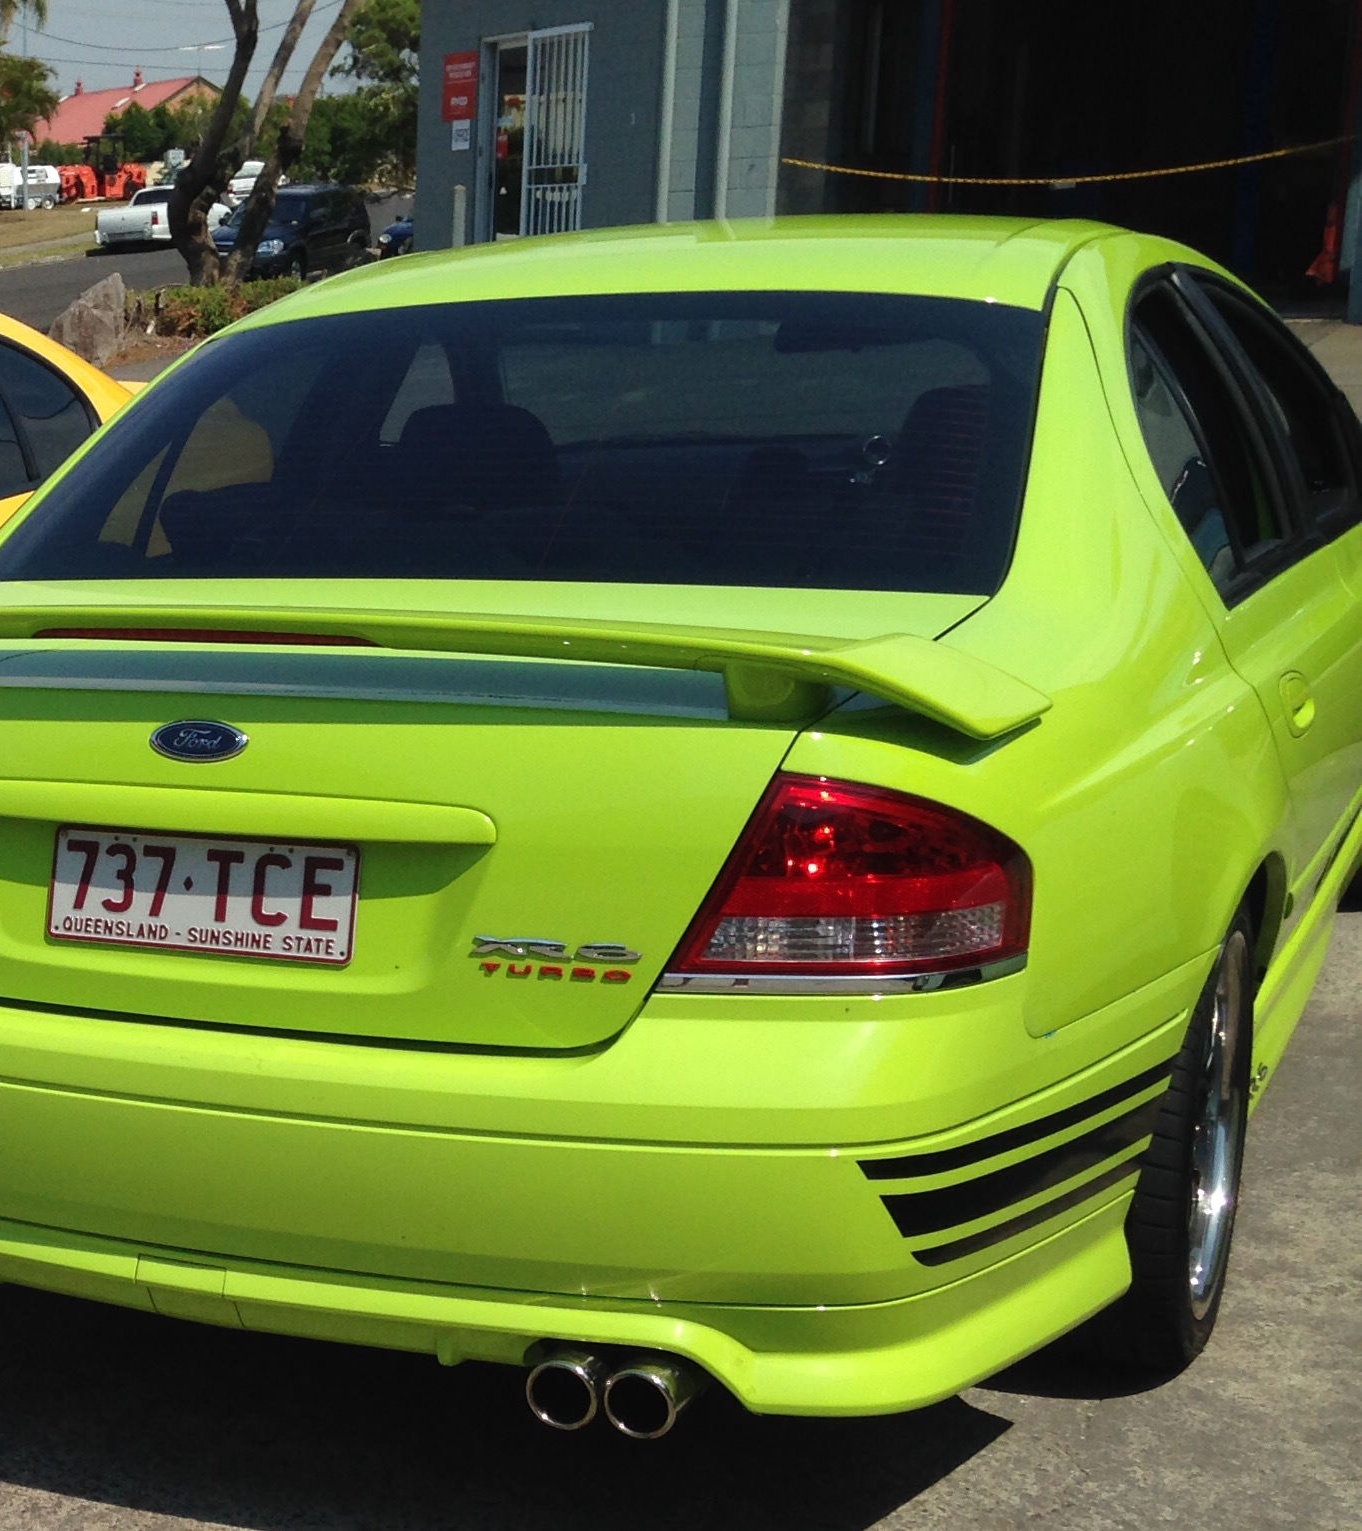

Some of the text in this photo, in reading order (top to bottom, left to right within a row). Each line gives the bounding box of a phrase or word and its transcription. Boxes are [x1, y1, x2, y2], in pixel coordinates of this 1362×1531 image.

[173, 728, 222, 749] Ford
[62, 915, 169, 941] QUEENSLAND
[187, 926, 273, 950] SUNSHINE
[282, 935, 336, 955] STATE
[472, 934, 642, 963] XR6
[480, 961, 632, 982] TURBO
